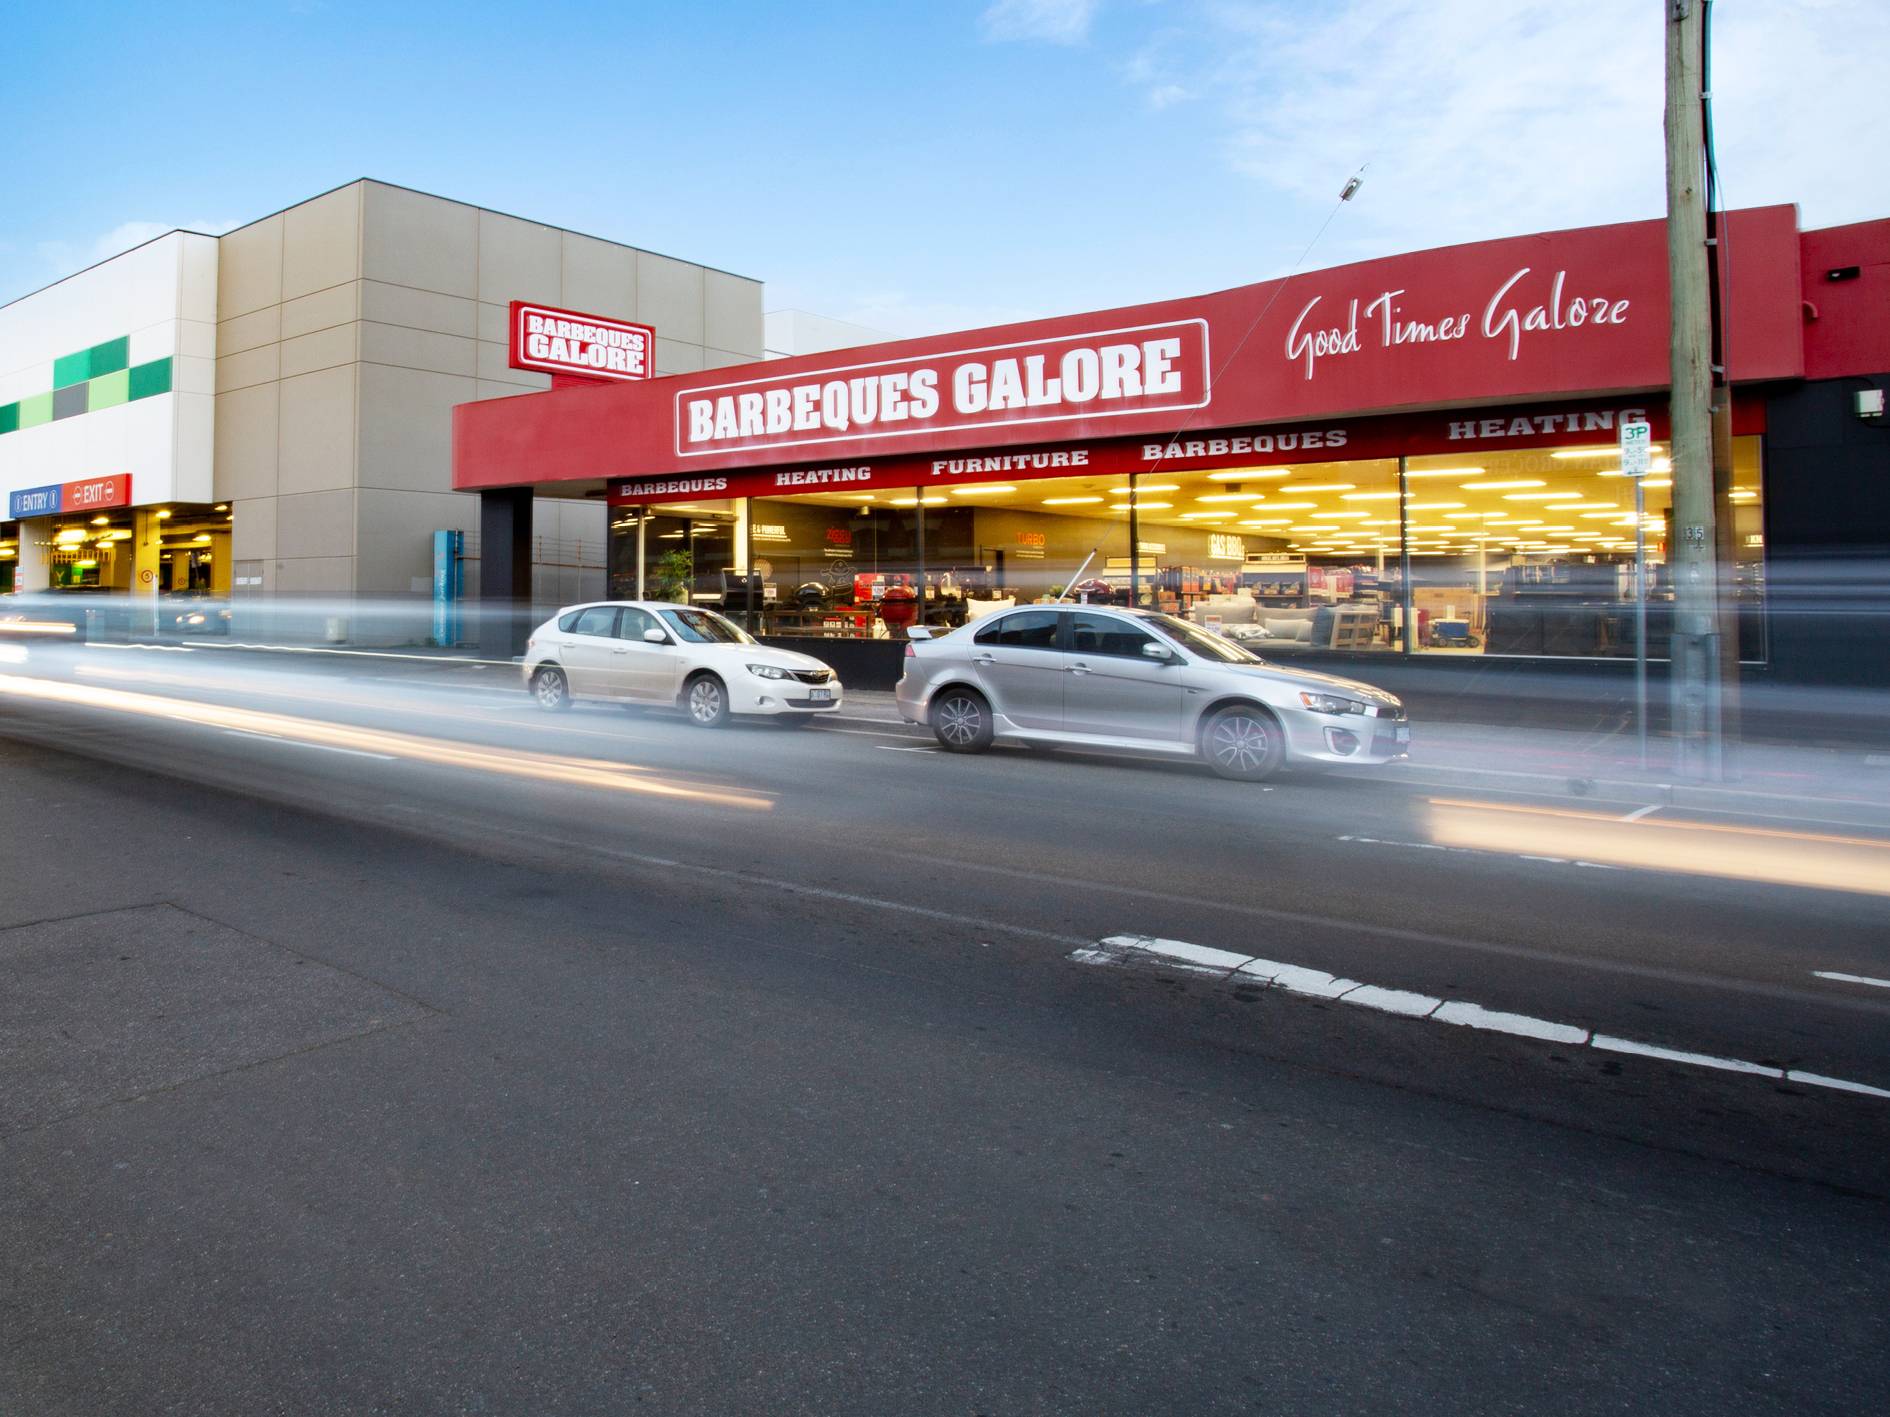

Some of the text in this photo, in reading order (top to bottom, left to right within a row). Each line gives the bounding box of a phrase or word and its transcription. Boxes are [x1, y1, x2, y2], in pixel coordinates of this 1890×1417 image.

[527, 314, 644, 352] BARBEQUES
[1286, 268, 1629, 380] Good Times Galore
[527, 333, 644, 374] GALORE
[688, 337, 1182, 443] BARBEQUES GALORE
[1449, 408, 1647, 440] HEATING
[1625, 426, 1648, 439] 3P
[1141, 430, 1348, 461] BARBEQUES
[775, 466, 871, 486] HEATING
[932, 450, 1089, 476] FURNITURE
[83, 483, 104, 503] EXIT
[621, 477, 727, 497] BARBEQUES
[22, 491, 49, 511] ENTRY
[1016, 532, 1045, 546] TURBO
